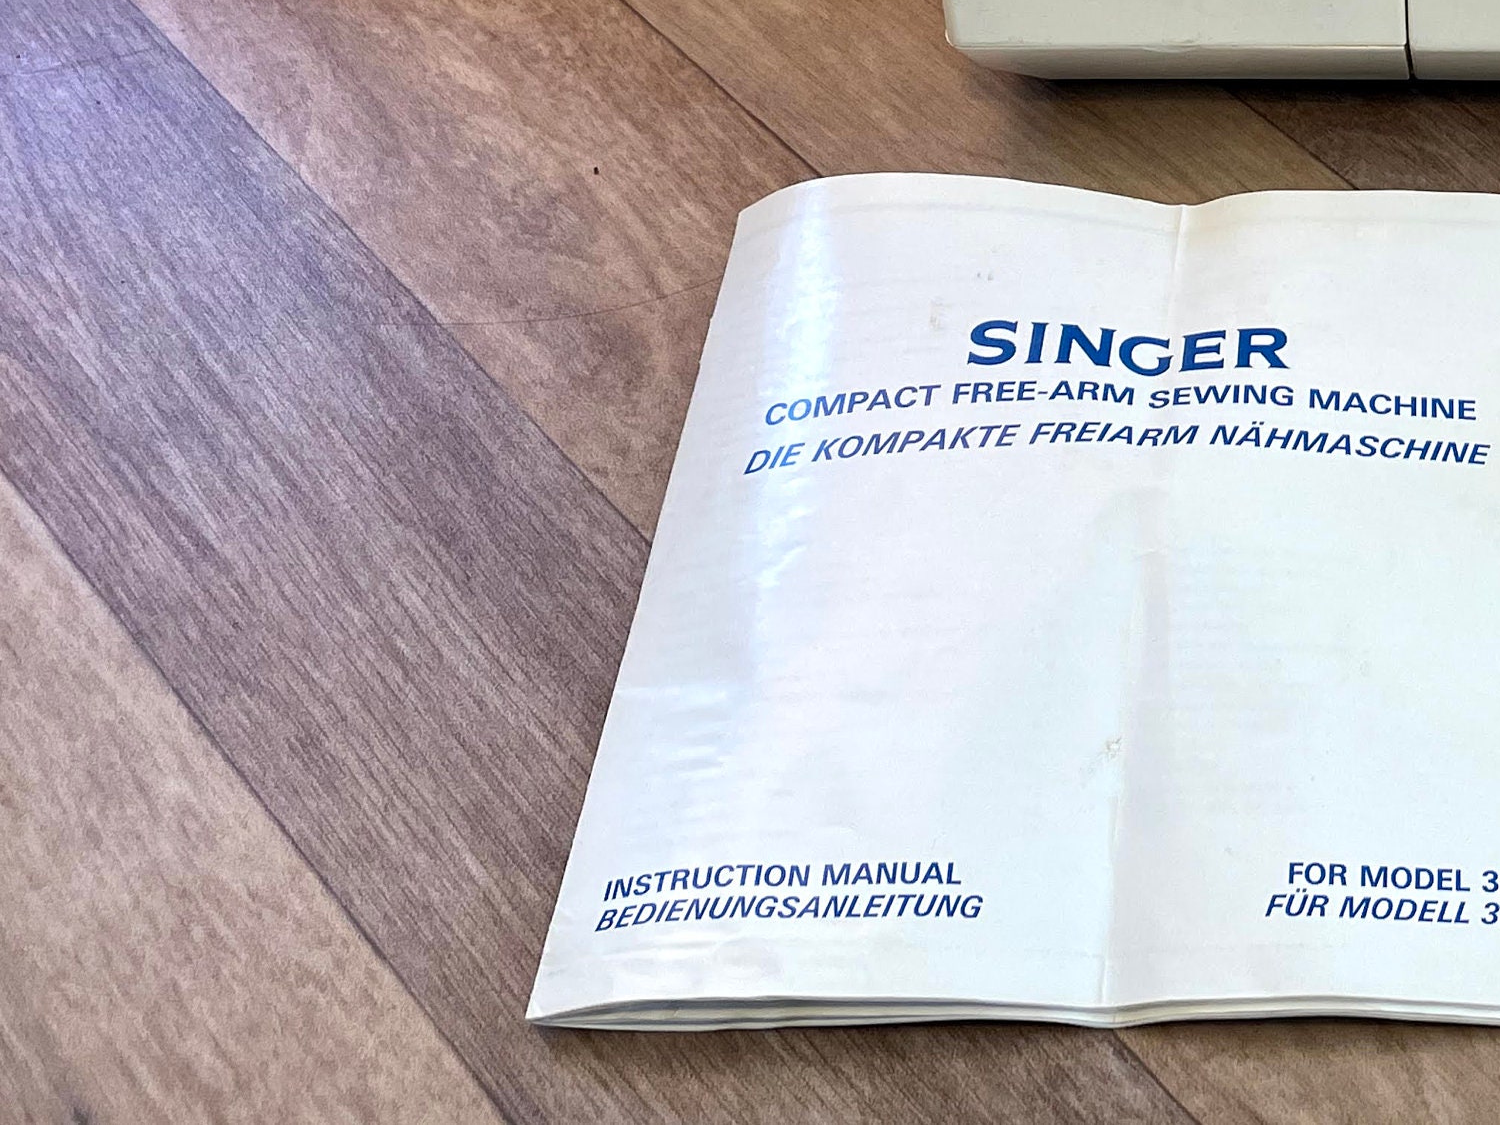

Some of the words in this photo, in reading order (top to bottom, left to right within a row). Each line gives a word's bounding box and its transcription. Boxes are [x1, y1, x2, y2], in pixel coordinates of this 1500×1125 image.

[966, 319, 1290, 378] SINGER
[764, 384, 942, 427] COMPACT
[952, 380, 1135, 407] FREE-ARM
[1148, 384, 1294, 410] SEWING
[1308, 388, 1477, 421] MACHINE
[743, 441, 806, 476] DIE
[811, 423, 1021, 463] KOMPAKTE
[1029, 421, 1200, 448] FREIARM
[1209, 419, 1489, 466] NÄHMASCHINE
[603, 863, 811, 902] INSTRUCTION
[821, 861, 961, 886] MANUAL
[1287, 861, 1348, 886] FOR
[1360, 864, 1471, 893] MODEL
[595, 893, 984, 932] BEDIENUNGSANLEITUNG
[1265, 888, 1330, 918] FÜR
[1338, 895, 1470, 924] MODELL
